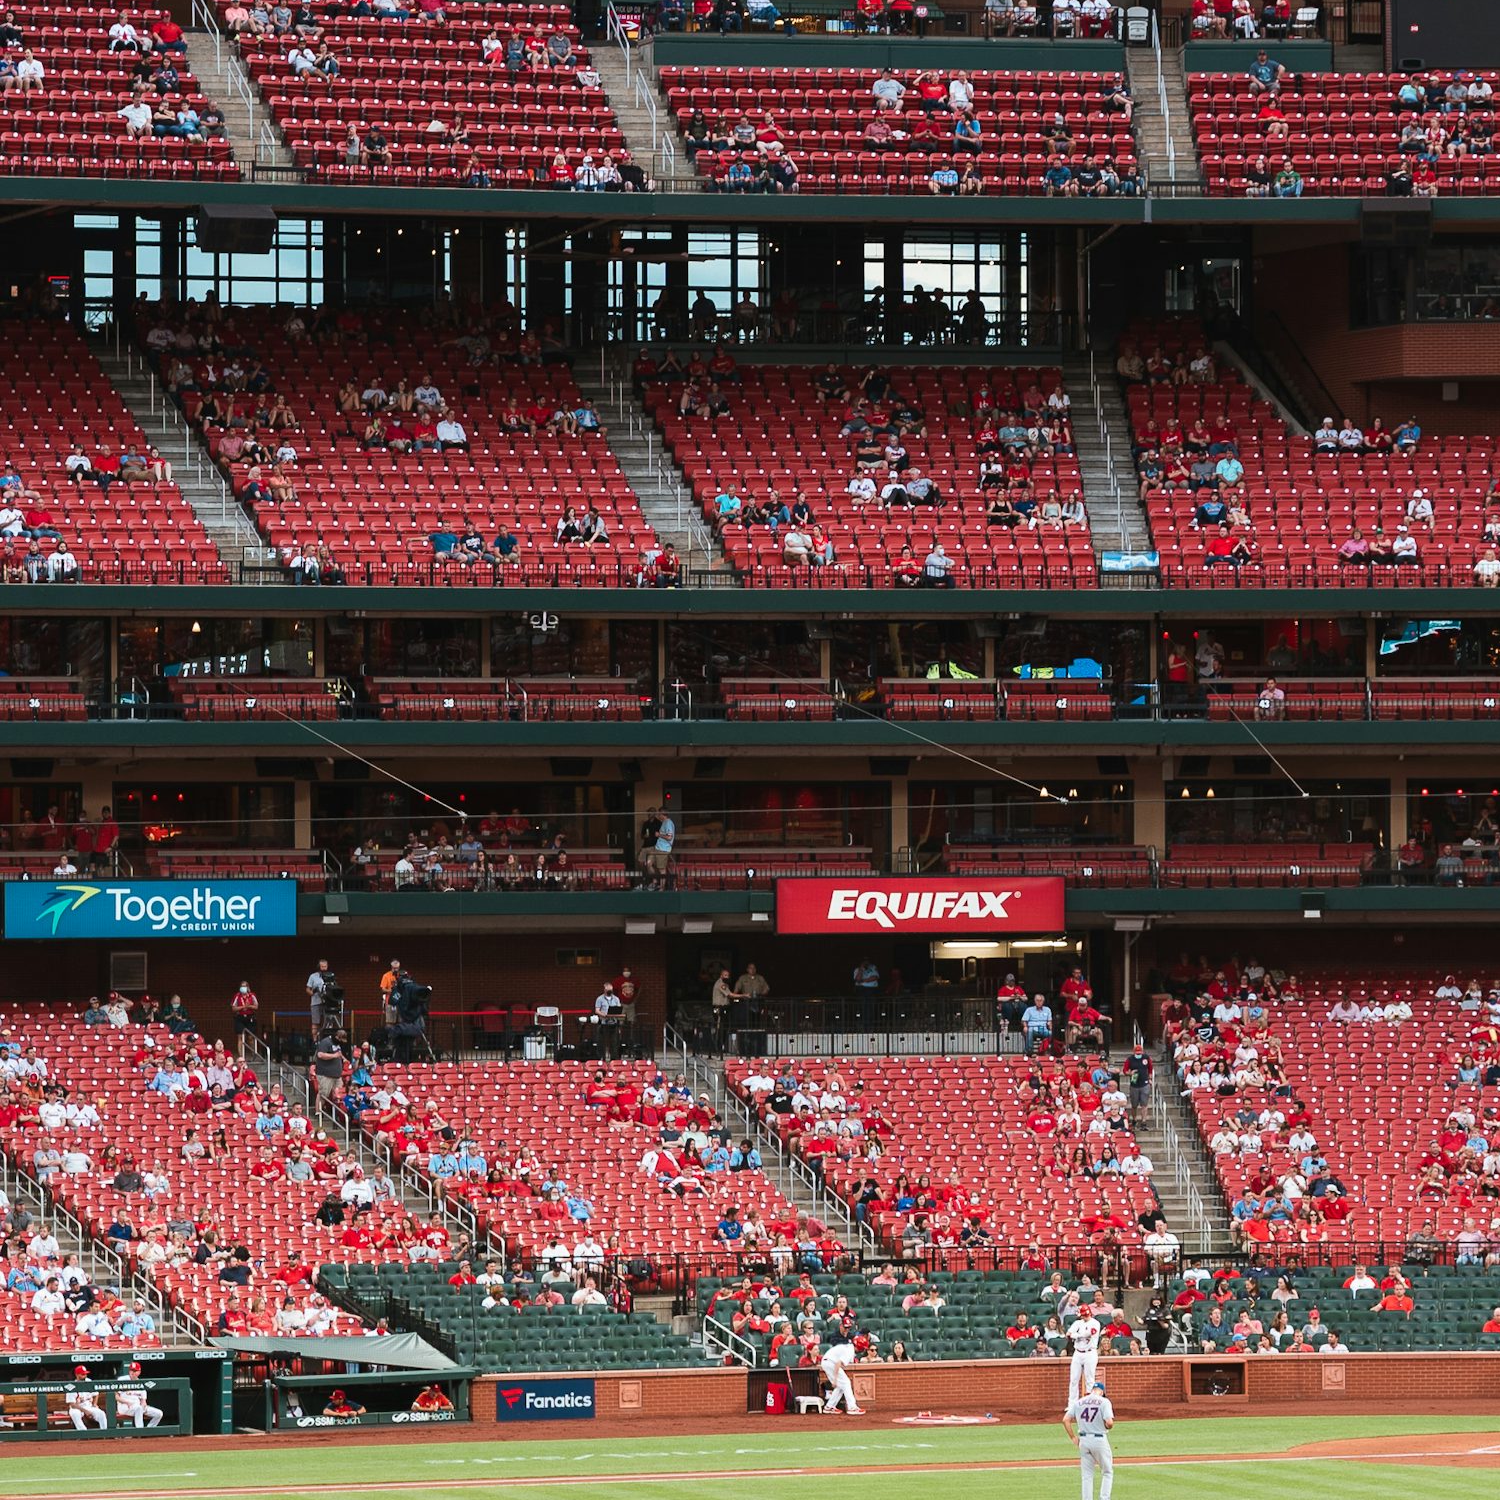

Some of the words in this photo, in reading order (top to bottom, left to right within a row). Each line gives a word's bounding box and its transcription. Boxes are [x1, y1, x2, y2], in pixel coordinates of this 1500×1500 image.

[29, 698, 40, 708] 36
[245, 698, 256, 708] 37
[443, 698, 454, 708] 38
[598, 699, 609, 709] 39
[785, 699, 796, 709] 40
[943, 699, 954, 709] 41
[1056, 698, 1067, 708] 42
[1259, 699, 1270, 709] 43
[1484, 698, 1495, 708] 44
[537, 870, 543, 879] 8
[748, 869, 754, 878] 9
[1083, 868, 1093, 876] 10
[106, 887, 261, 930] Together
[827, 889, 1013, 928] EQUIFAX
[222, 923, 255, 931] UNION
[71, 1354, 104, 1362] GEICO
[132, 1352, 165, 1361] GEICO
[195, 1350, 227, 1359] GEICO
[9, 1356, 41, 1364] GEICO
[525, 1391, 592, 1409] Fanatics
[410, 1411, 455, 1421] SSMHealth
[1081, 1407, 1099, 1422] 47
